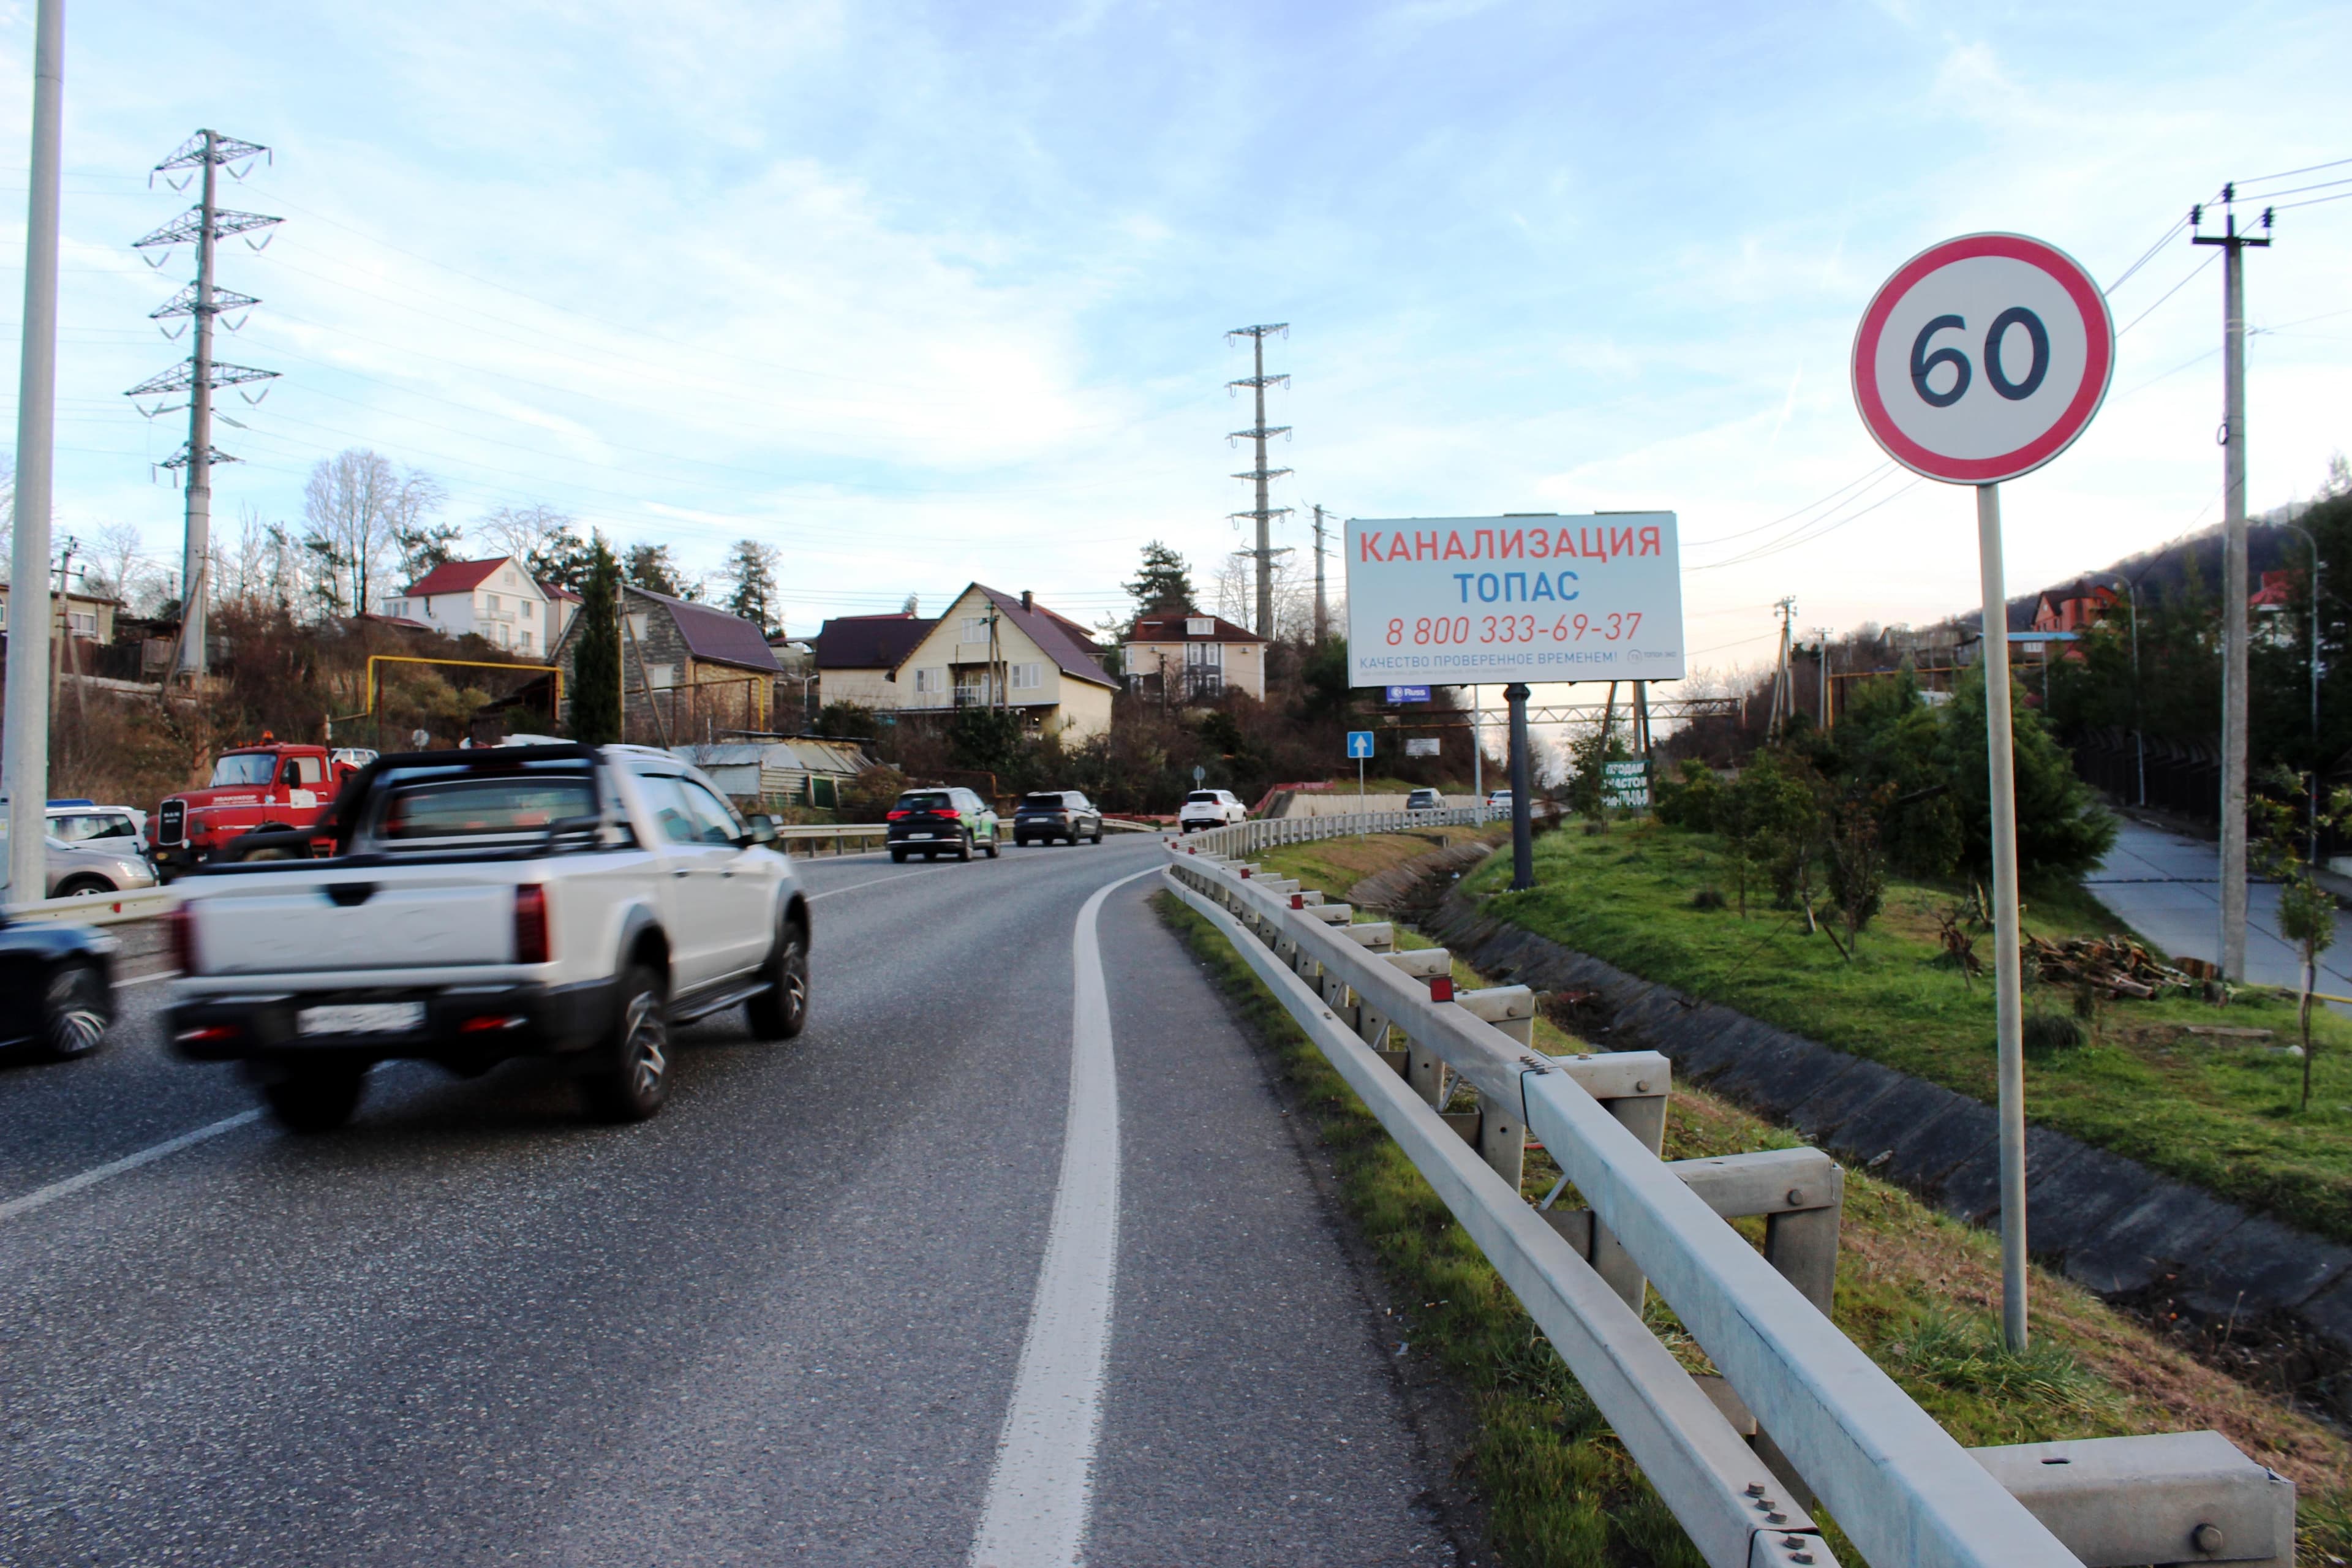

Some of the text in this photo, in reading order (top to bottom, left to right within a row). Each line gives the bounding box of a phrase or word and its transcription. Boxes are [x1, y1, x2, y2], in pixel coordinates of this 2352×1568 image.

[1910, 306, 2051, 408] 60
[1360, 526, 1661, 563] КАНАЛИЗАЦИЯ
[1453, 570, 1580, 603] ТОПАС
[1386, 612, 1643, 646] 8 800 333-69-37
[1360, 652, 1617, 668] КАЧЕСТВО ПРОВЕРЕННОЕ ВРЕМЕНЕМ!
